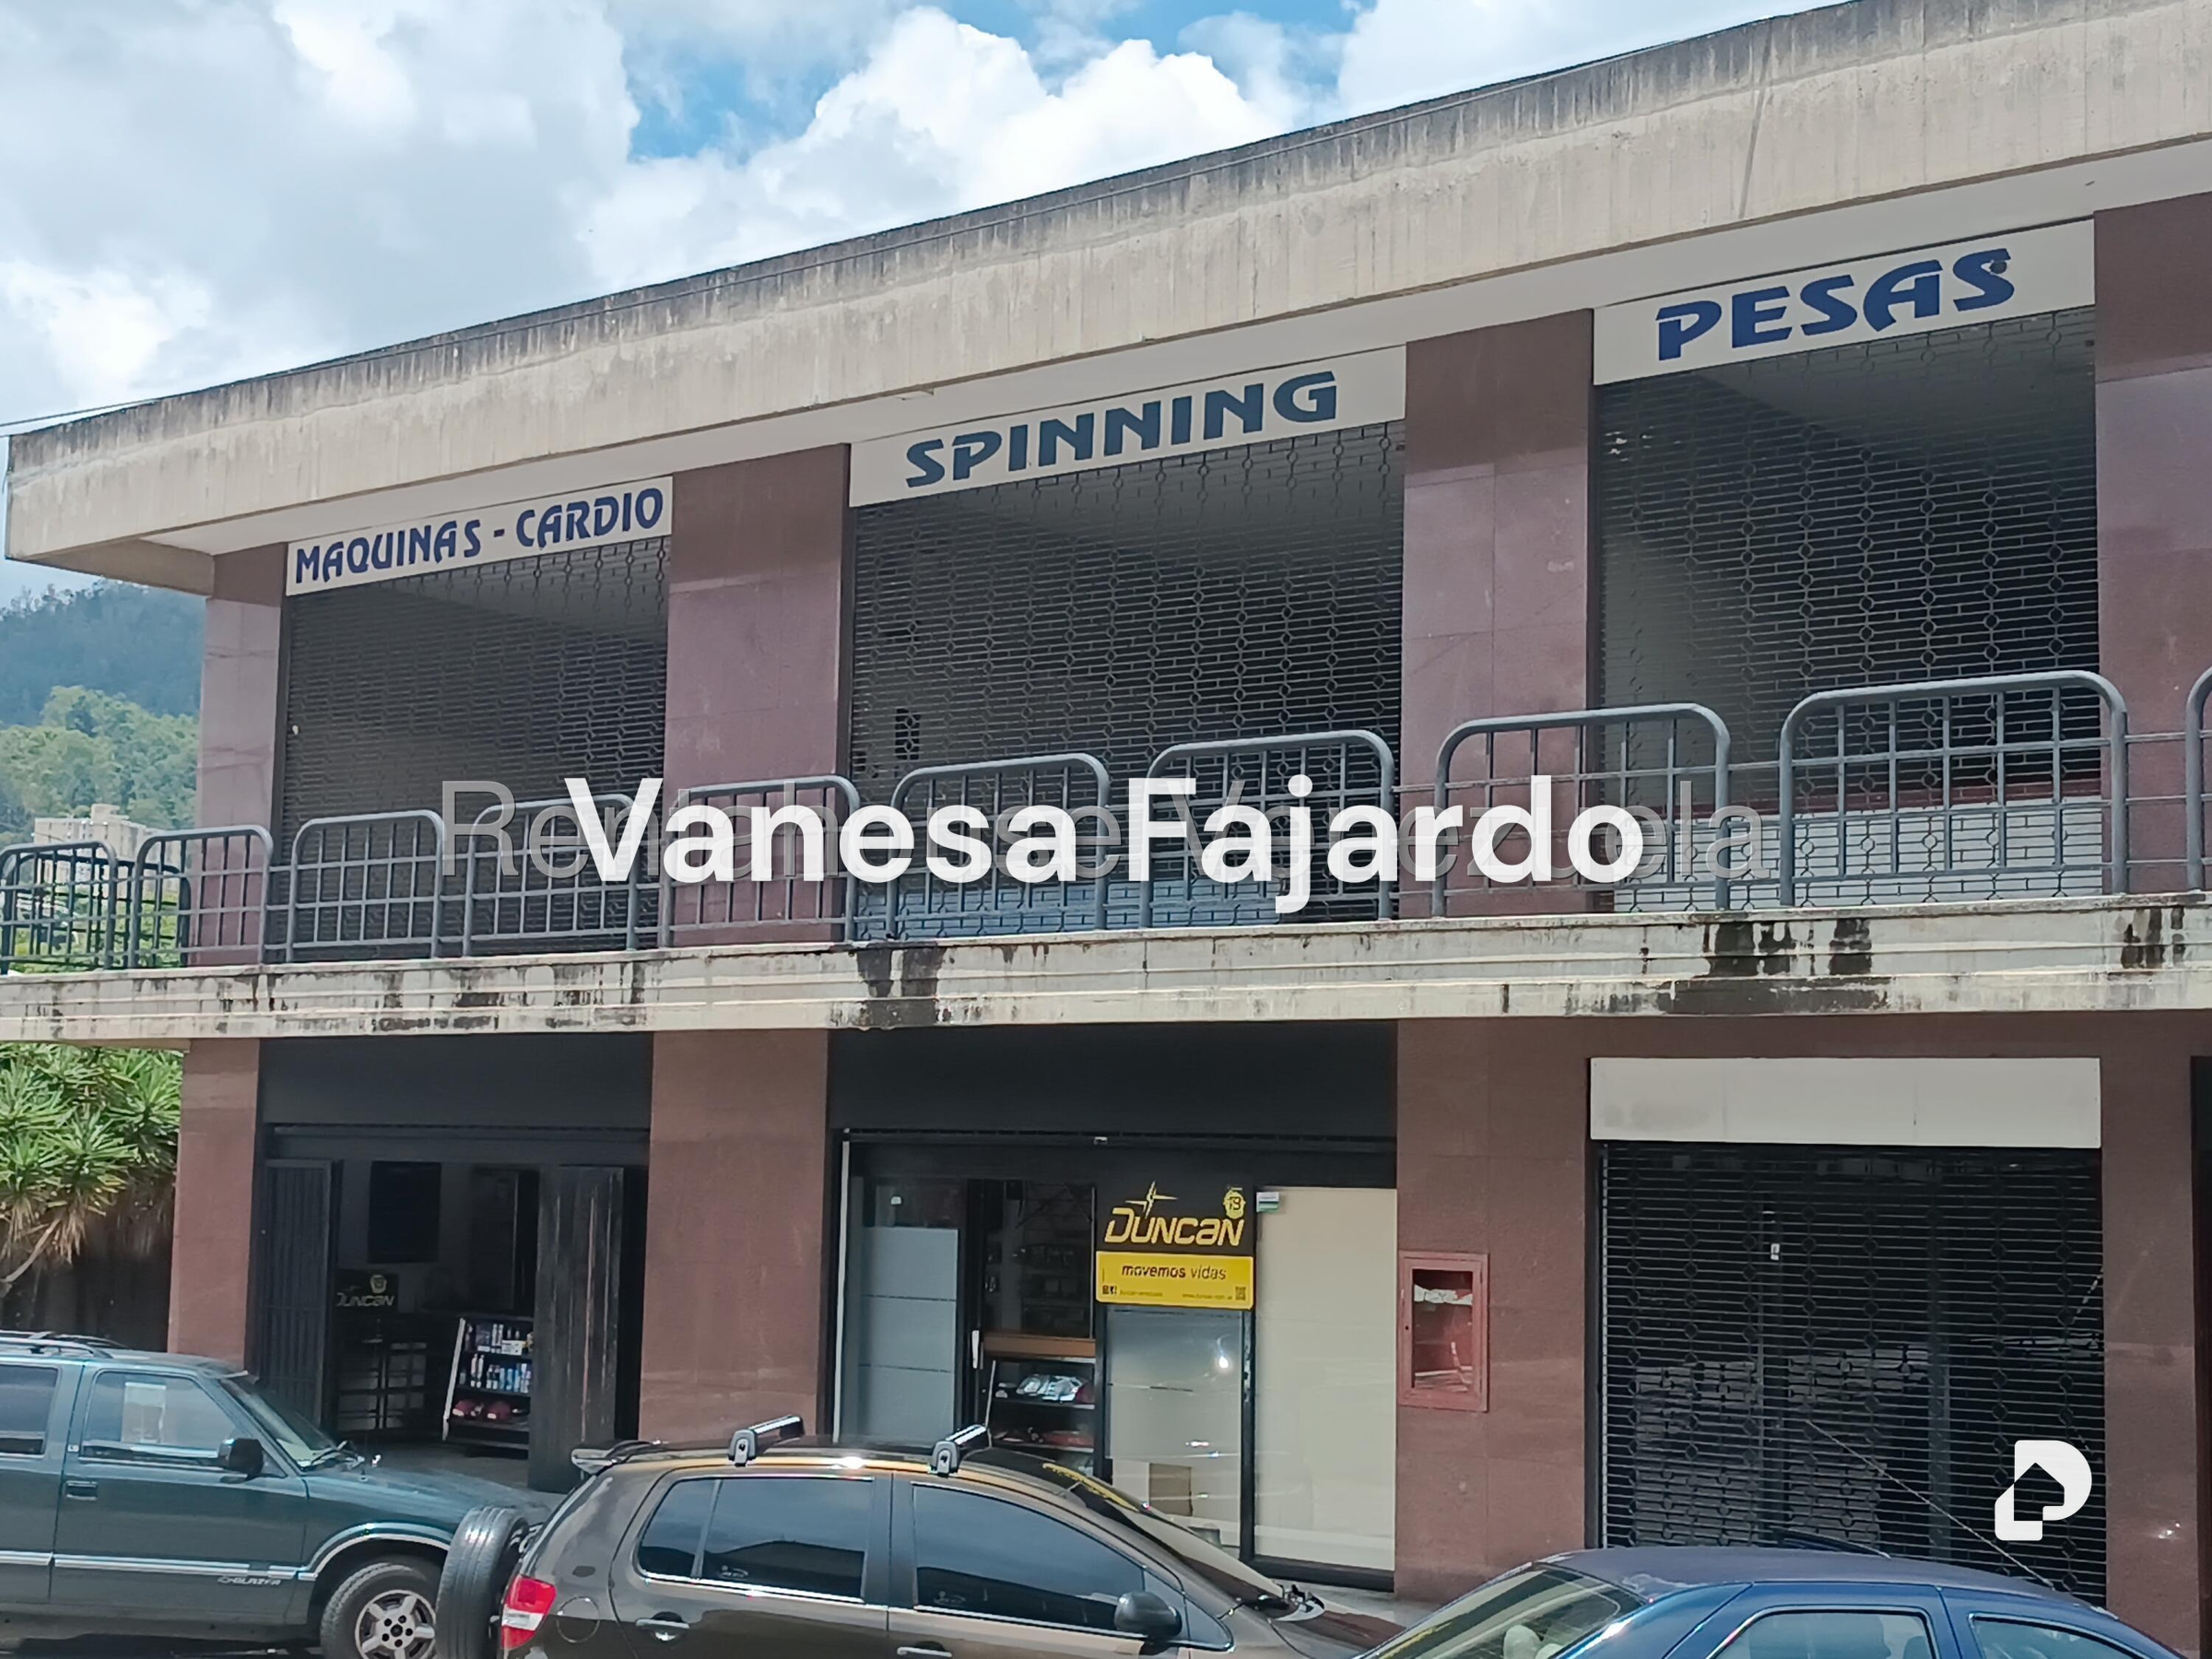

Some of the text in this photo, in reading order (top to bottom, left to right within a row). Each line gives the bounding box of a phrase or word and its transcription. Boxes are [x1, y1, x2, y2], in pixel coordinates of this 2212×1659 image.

[1656, 248, 2016, 361] PESAS
[905, 371, 1337, 488] SPINNING
[295, 519, 481, 583] MAQUINAS
[516, 488, 664, 549] CARDIO
[1121, 1265, 1227, 1280] movemos vidas
